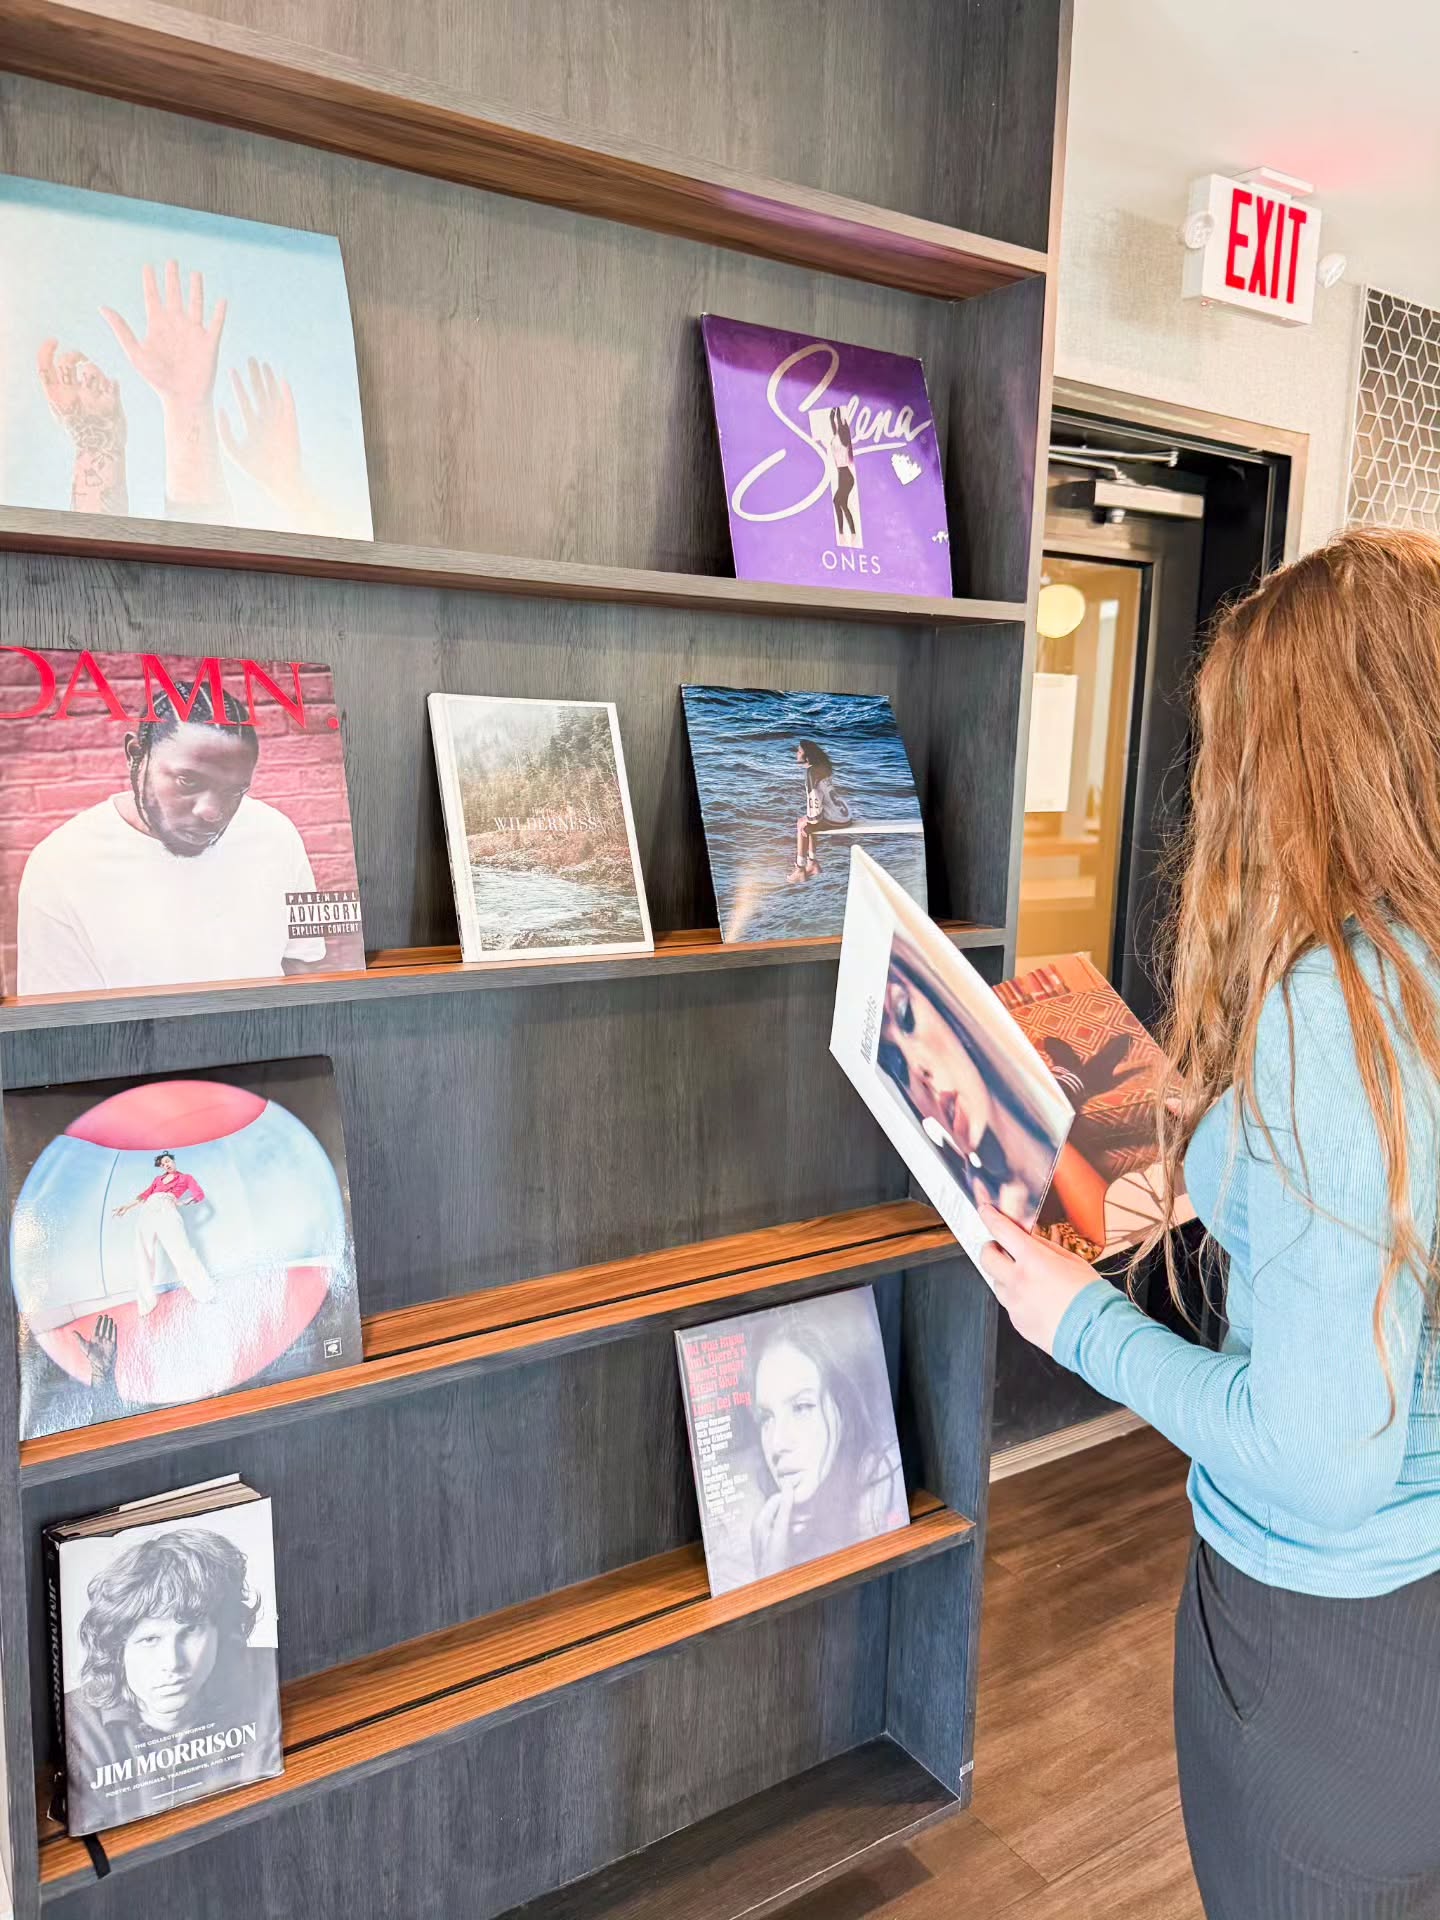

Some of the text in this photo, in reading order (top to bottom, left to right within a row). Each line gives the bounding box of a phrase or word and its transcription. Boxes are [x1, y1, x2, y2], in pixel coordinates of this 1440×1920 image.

[1226, 188, 1308, 304] EXIT
[822, 550, 881, 575] ONES
[0, 646, 340, 729] DAMN.
[494, 815, 598, 832] WILDERNESS
[288, 892, 357, 904] PARENTAL
[289, 903, 358, 923] ADVISORY
[291, 923, 359, 936] EXPLICIT CONTENT
[859, 993, 877, 1065] Midnights
[134, 1722, 216, 1750] THE COLLECTED WORKS OF
[90, 1722, 257, 1790] JIM MORRISON
[105, 1787, 132, 1799] POETRY,
[210, 1758, 224, 1767] AND
[224, 1752, 245, 1763] LYRICS
